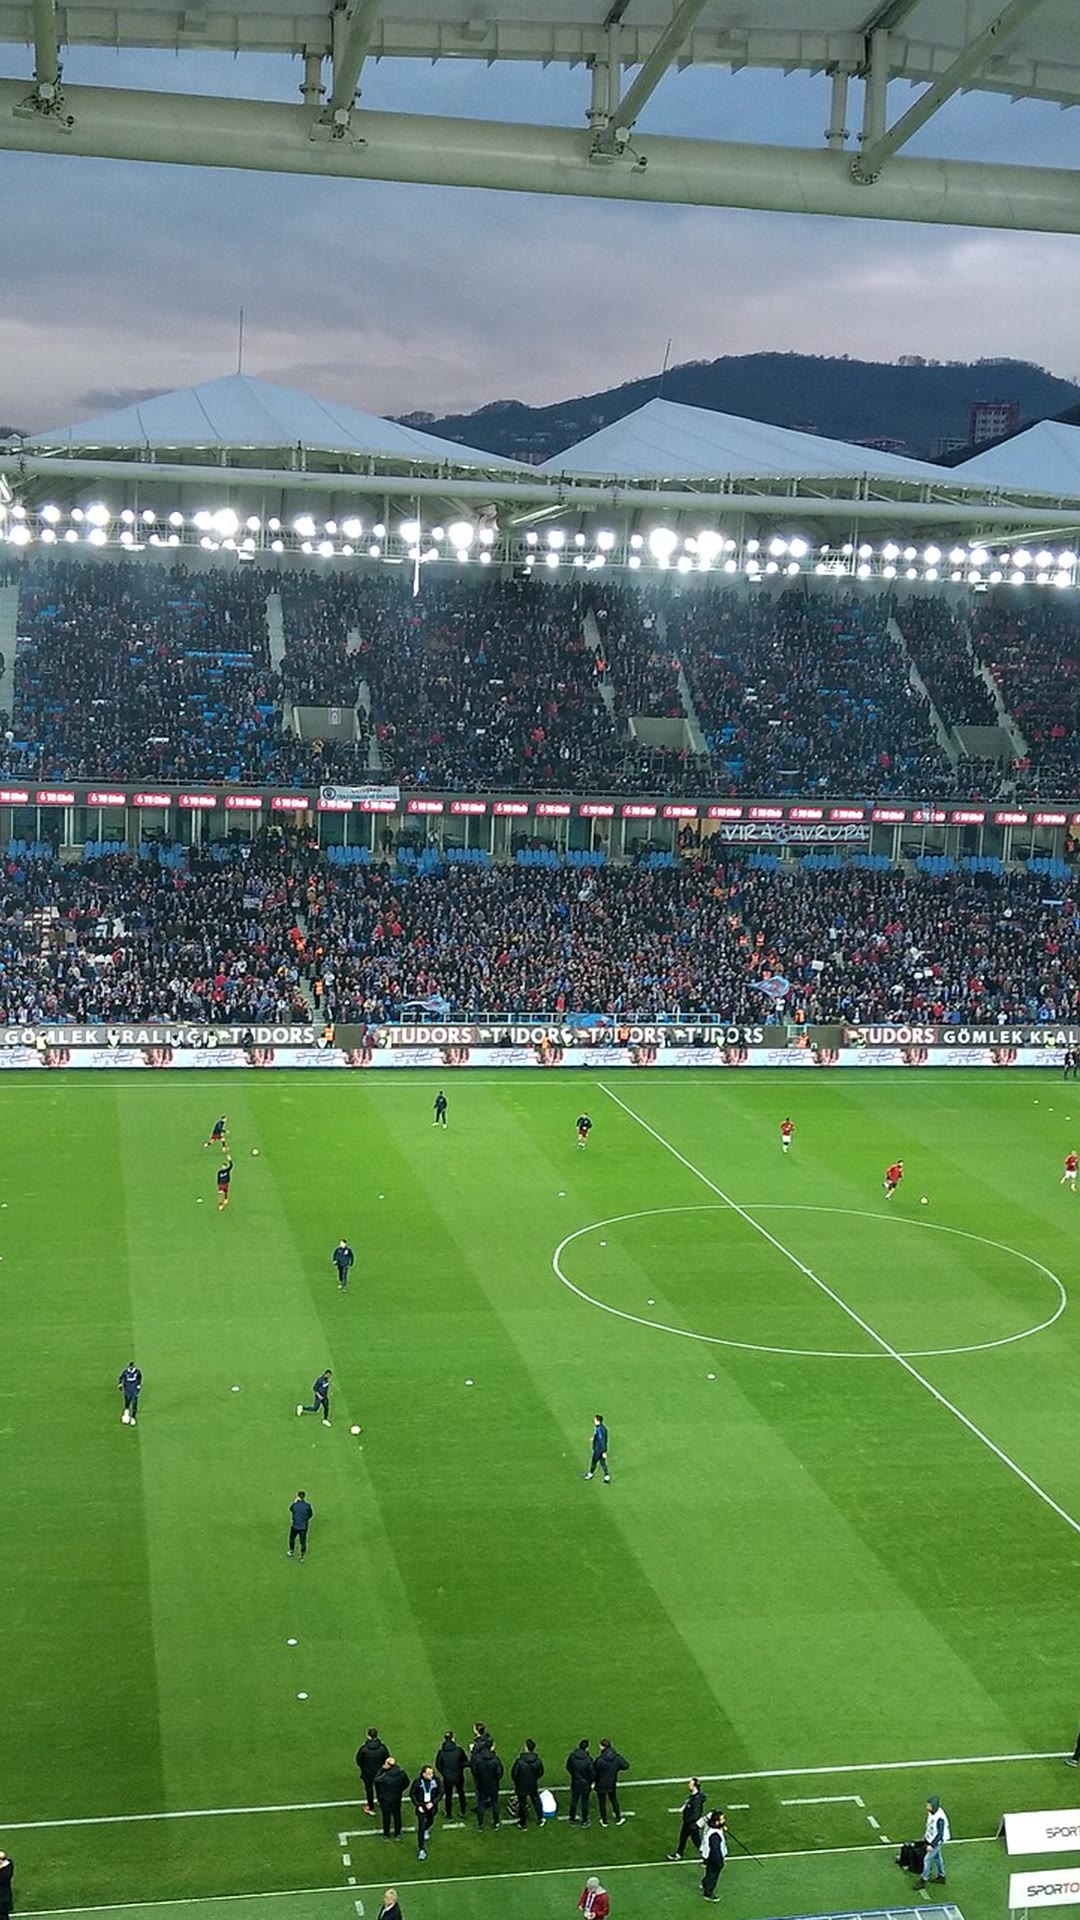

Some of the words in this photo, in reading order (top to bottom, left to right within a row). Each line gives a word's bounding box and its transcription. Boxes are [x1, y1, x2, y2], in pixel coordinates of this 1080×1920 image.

[725, 823, 774, 841] VIRA
[793, 823, 866, 841] AVRUPA
[390, 1027, 472, 1044] TUDORS
[858, 1027, 935, 1044] TUDORS
[943, 1027, 1023, 1044] GÖMLEK
